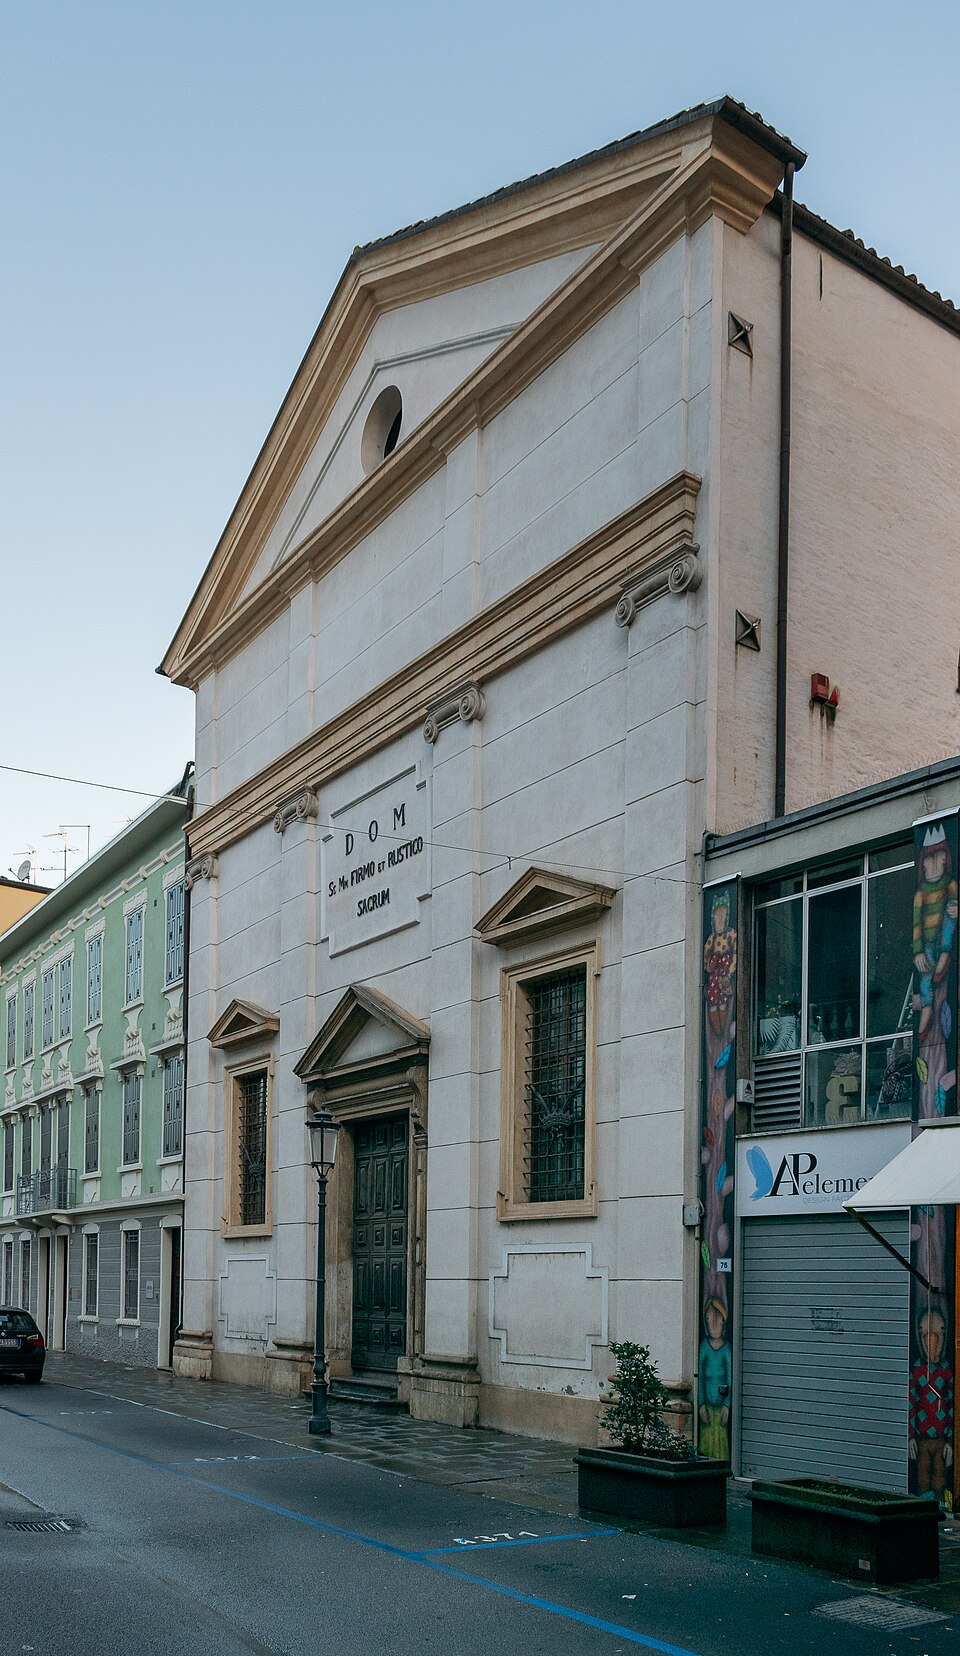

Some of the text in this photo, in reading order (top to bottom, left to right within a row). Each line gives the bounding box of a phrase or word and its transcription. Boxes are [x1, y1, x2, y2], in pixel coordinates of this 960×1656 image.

[345, 803, 406, 856] D O M
[350, 861, 375, 886] FIRMO
[388, 836, 424, 868] RUSTICO
[357, 888, 391, 917] SACRUM
[803, 1196, 830, 1204] DESIGN
